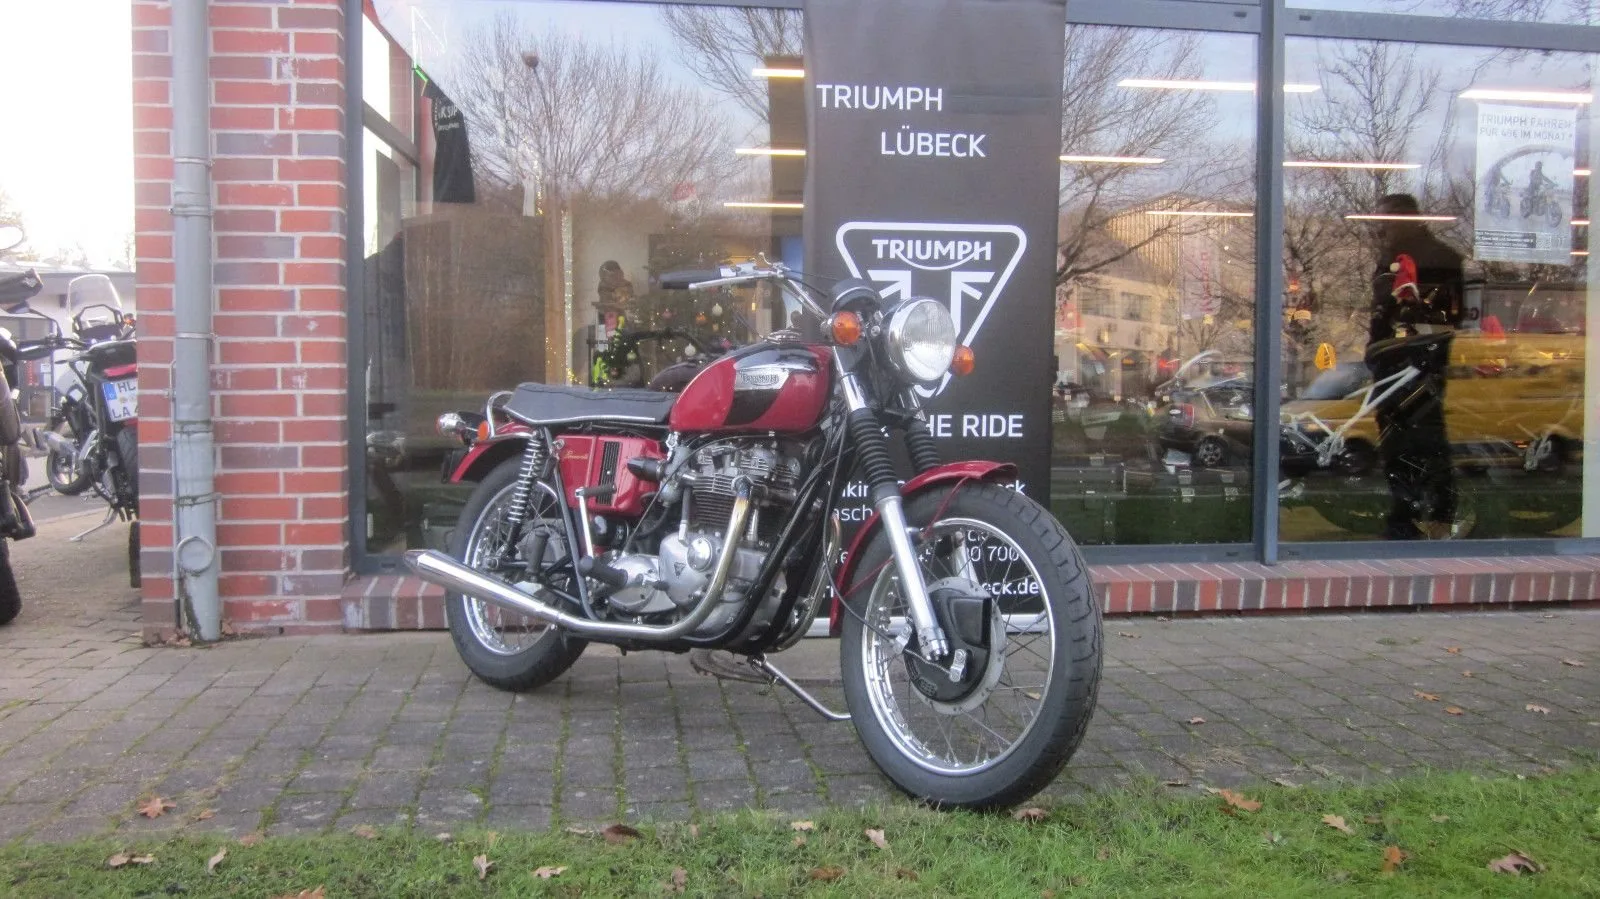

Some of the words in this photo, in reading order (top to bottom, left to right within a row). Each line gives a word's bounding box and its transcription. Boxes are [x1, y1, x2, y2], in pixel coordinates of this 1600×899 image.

[816, 84, 943, 111] TRIUMPH
[1480, 114, 1527, 127] TRIUMPH
[881, 125, 986, 157] LÜBECK
[872, 239, 992, 264] TRIUMPH
[925, 414, 952, 437] HE
[963, 415, 1023, 438] RIDE
